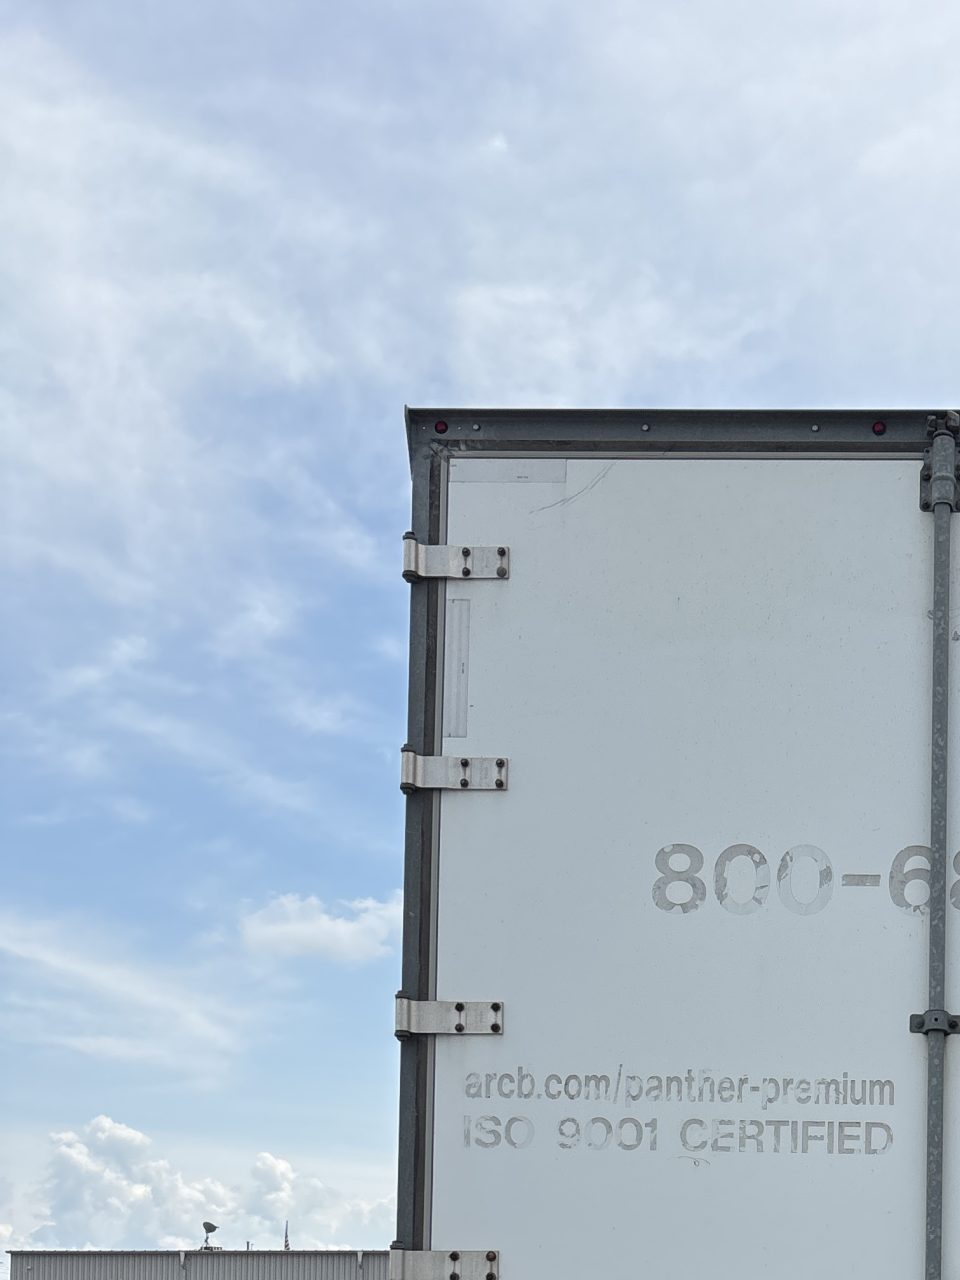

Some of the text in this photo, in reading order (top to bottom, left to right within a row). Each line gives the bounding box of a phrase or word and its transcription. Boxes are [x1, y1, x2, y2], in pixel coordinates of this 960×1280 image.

[464, 1063, 896, 1110] arcb.com/panther-premium
[463, 1115, 535, 1150] ISO
[679, 1118, 895, 1156] CERTIFIED
